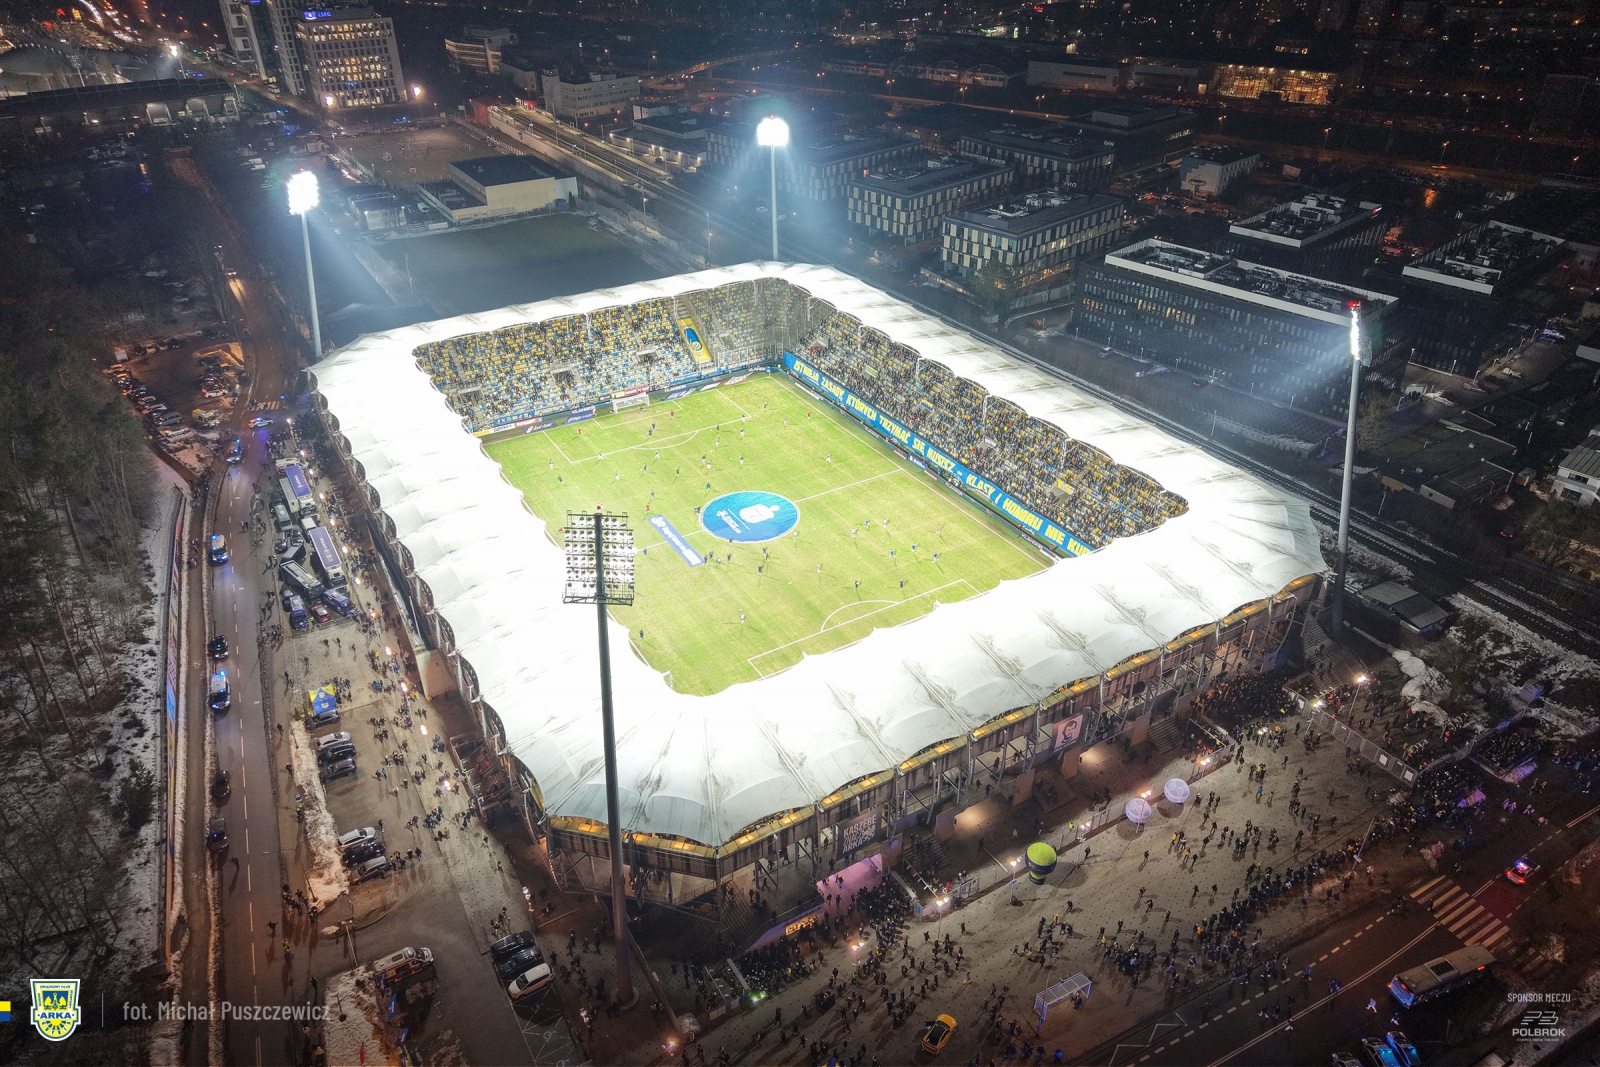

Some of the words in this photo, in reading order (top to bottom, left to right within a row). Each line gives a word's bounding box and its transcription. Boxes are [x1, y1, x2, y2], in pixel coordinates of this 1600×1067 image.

[966, 474, 996, 498] KLASY
[1002, 498, 1043, 531] HONORU
[1044, 524, 1066, 545] NIE
[842, 838, 863, 854] ARKA
